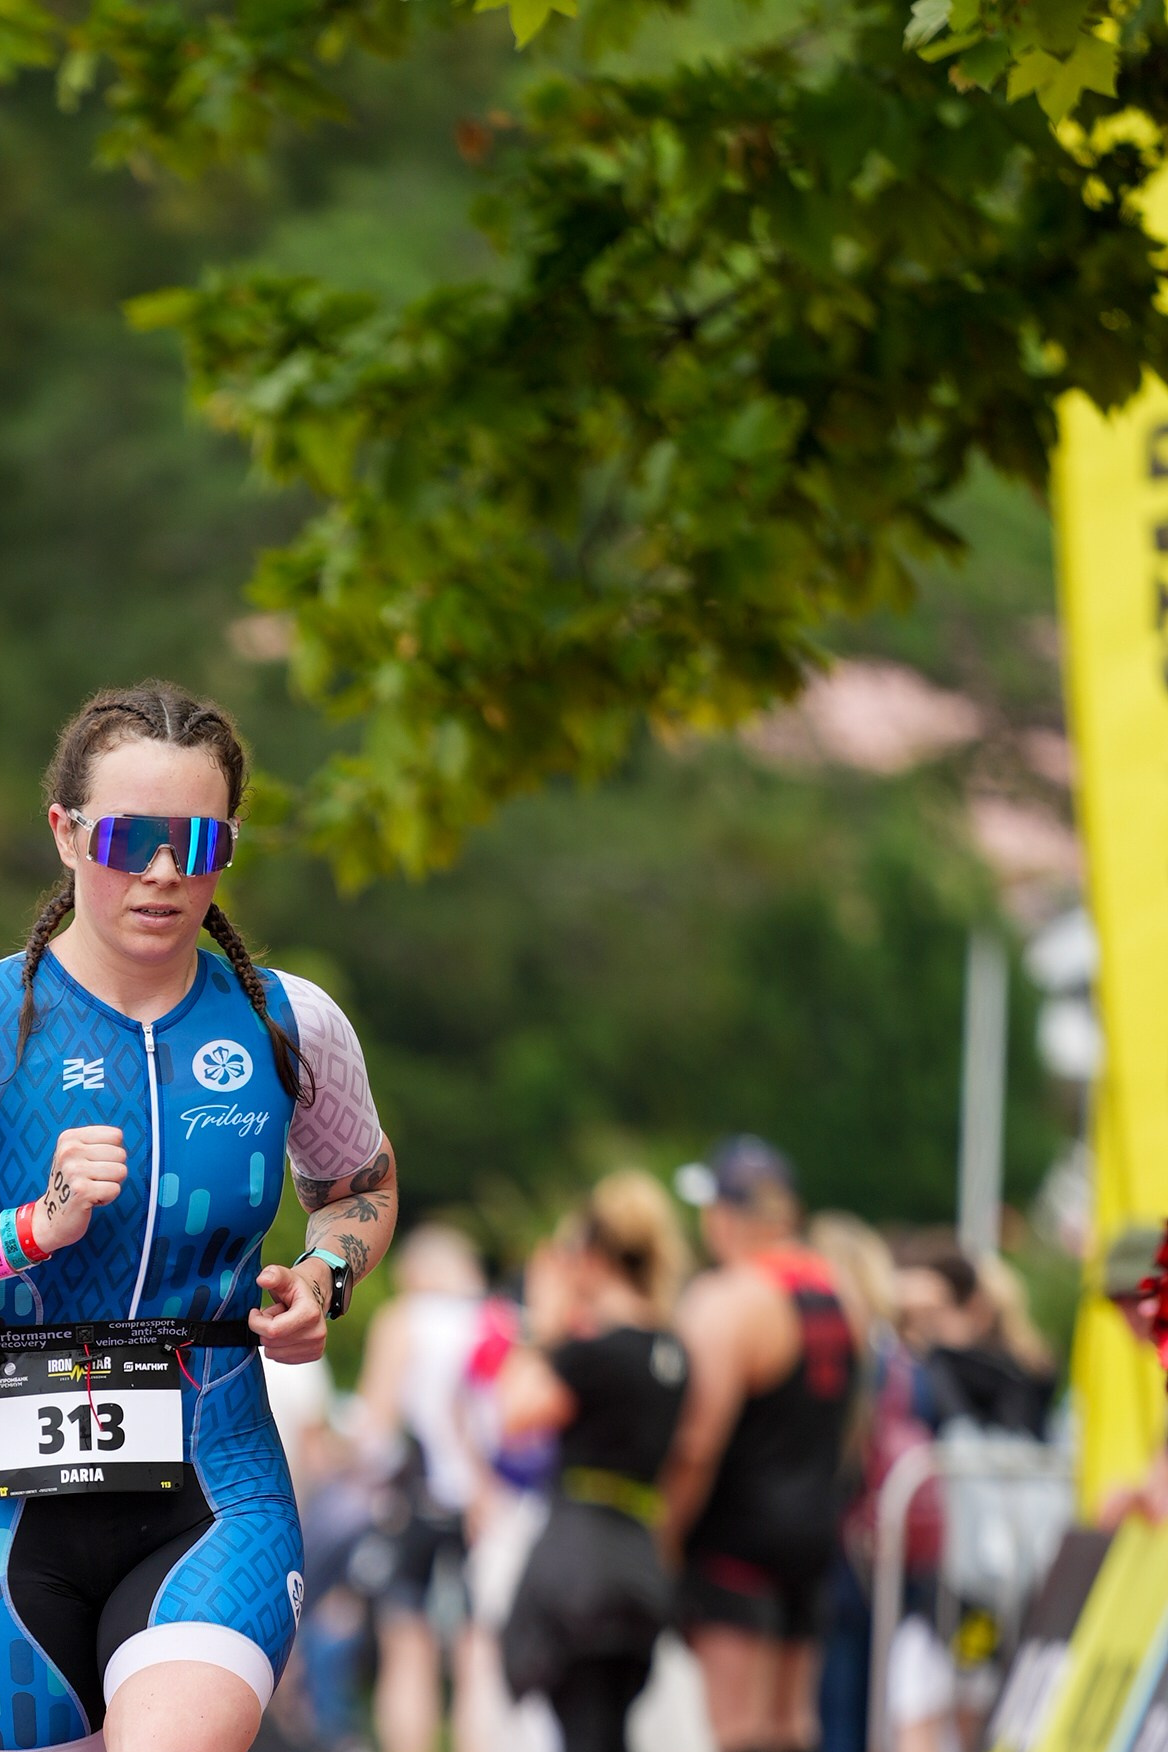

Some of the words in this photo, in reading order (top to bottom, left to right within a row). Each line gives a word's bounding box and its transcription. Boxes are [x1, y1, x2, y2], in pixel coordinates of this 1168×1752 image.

[180, 1103, 270, 1140] Trilogy
[108, 1320, 176, 1330] compressport
[131, 1326, 188, 1337] anti-shock
[95, 1336, 158, 1347] veino-active
[47, 1358, 73, 1373] IRON
[134, 1362, 169, 1371] МАГНИТ
[37, 1401, 126, 1455] 313
[60, 1468, 104, 1484] DARIA
[160, 1481, 172, 1489] 113
